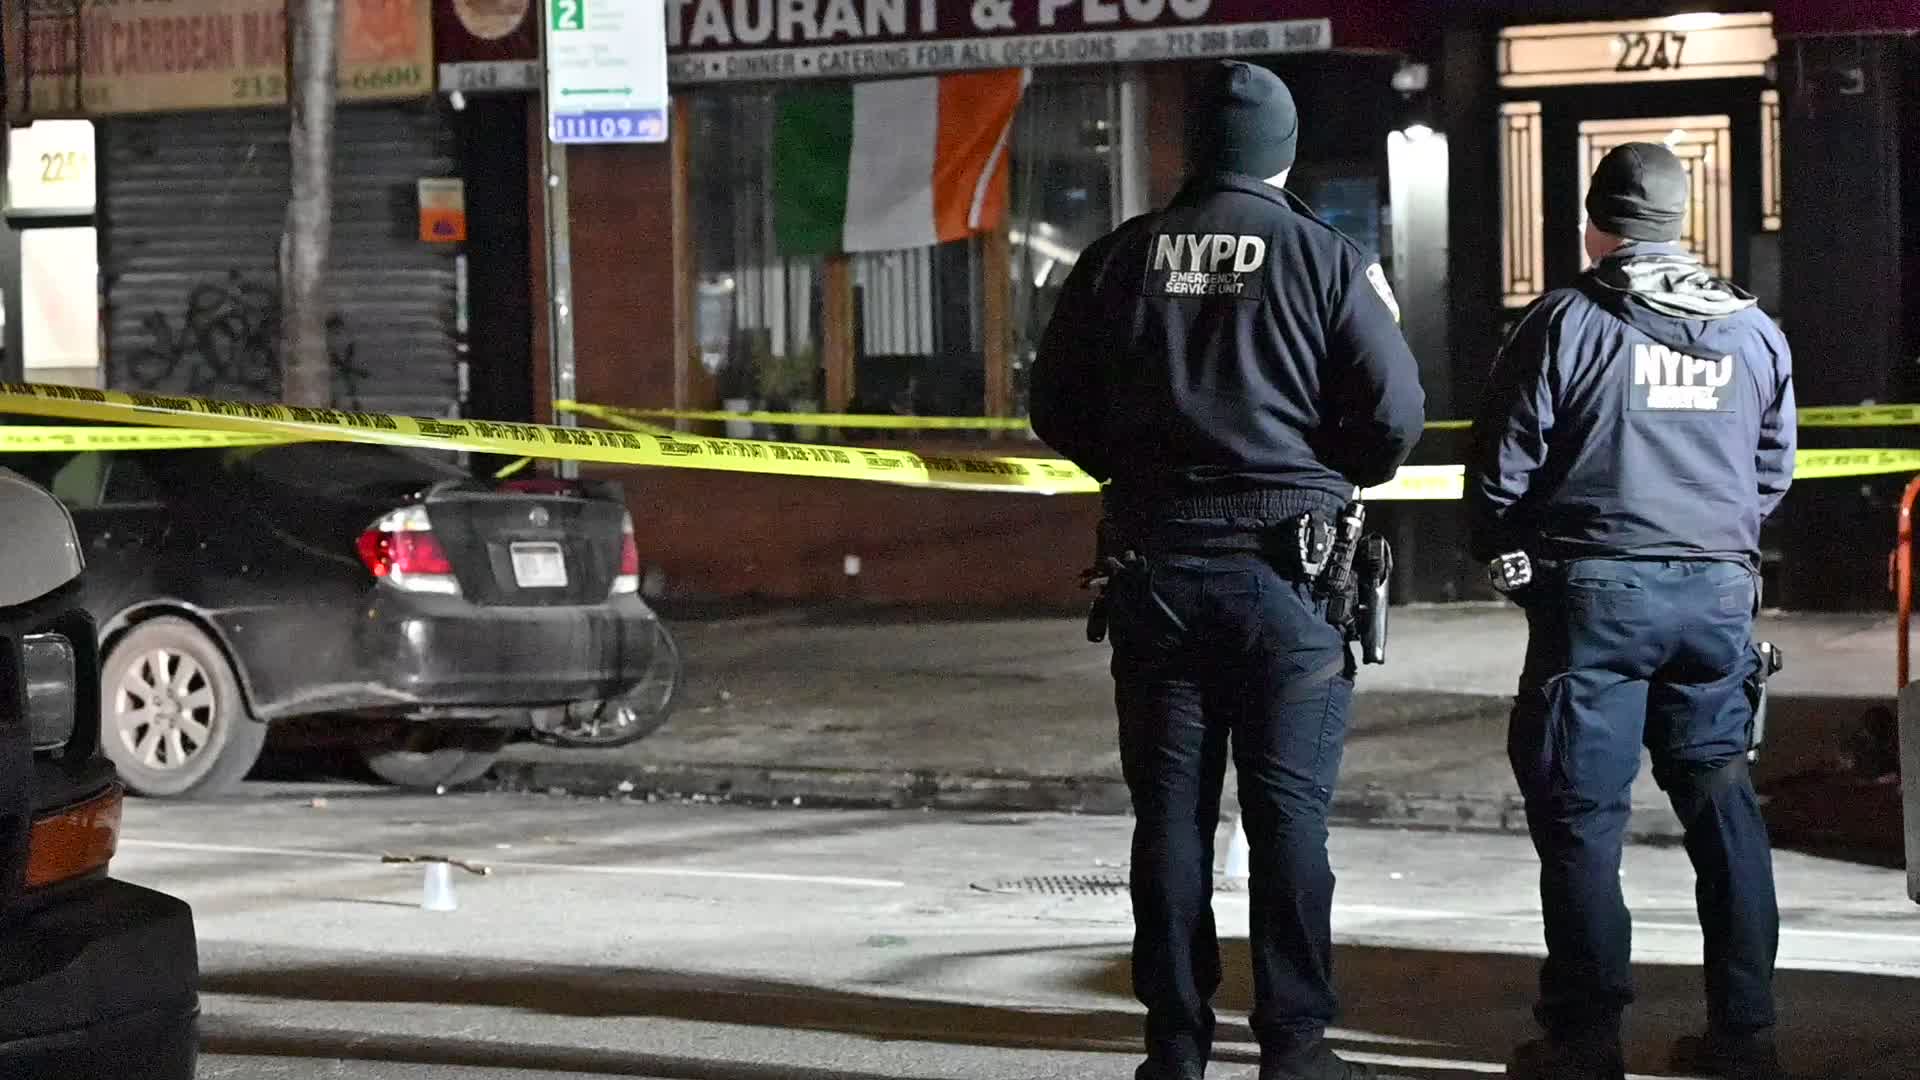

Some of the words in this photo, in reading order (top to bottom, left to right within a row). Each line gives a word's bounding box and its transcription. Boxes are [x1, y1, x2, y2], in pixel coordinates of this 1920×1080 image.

[557, 0, 578, 29] 2
[726, 56, 794, 80] DINNER
[816, 49, 909, 76] CATERING
[917, 45, 956, 68] FOR
[961, 43, 993, 66] ALL
[1002, 36, 1115, 63] OCCASIONS
[1615, 30, 1687, 71] 2247
[1153, 233, 1266, 272] NYPD
[1165, 282, 1216, 295] SERVICE
[1218, 283, 1244, 295] UNIT
[1169, 271, 1241, 284] EMERGENCY
[1634, 343, 1733, 387] NYPD
